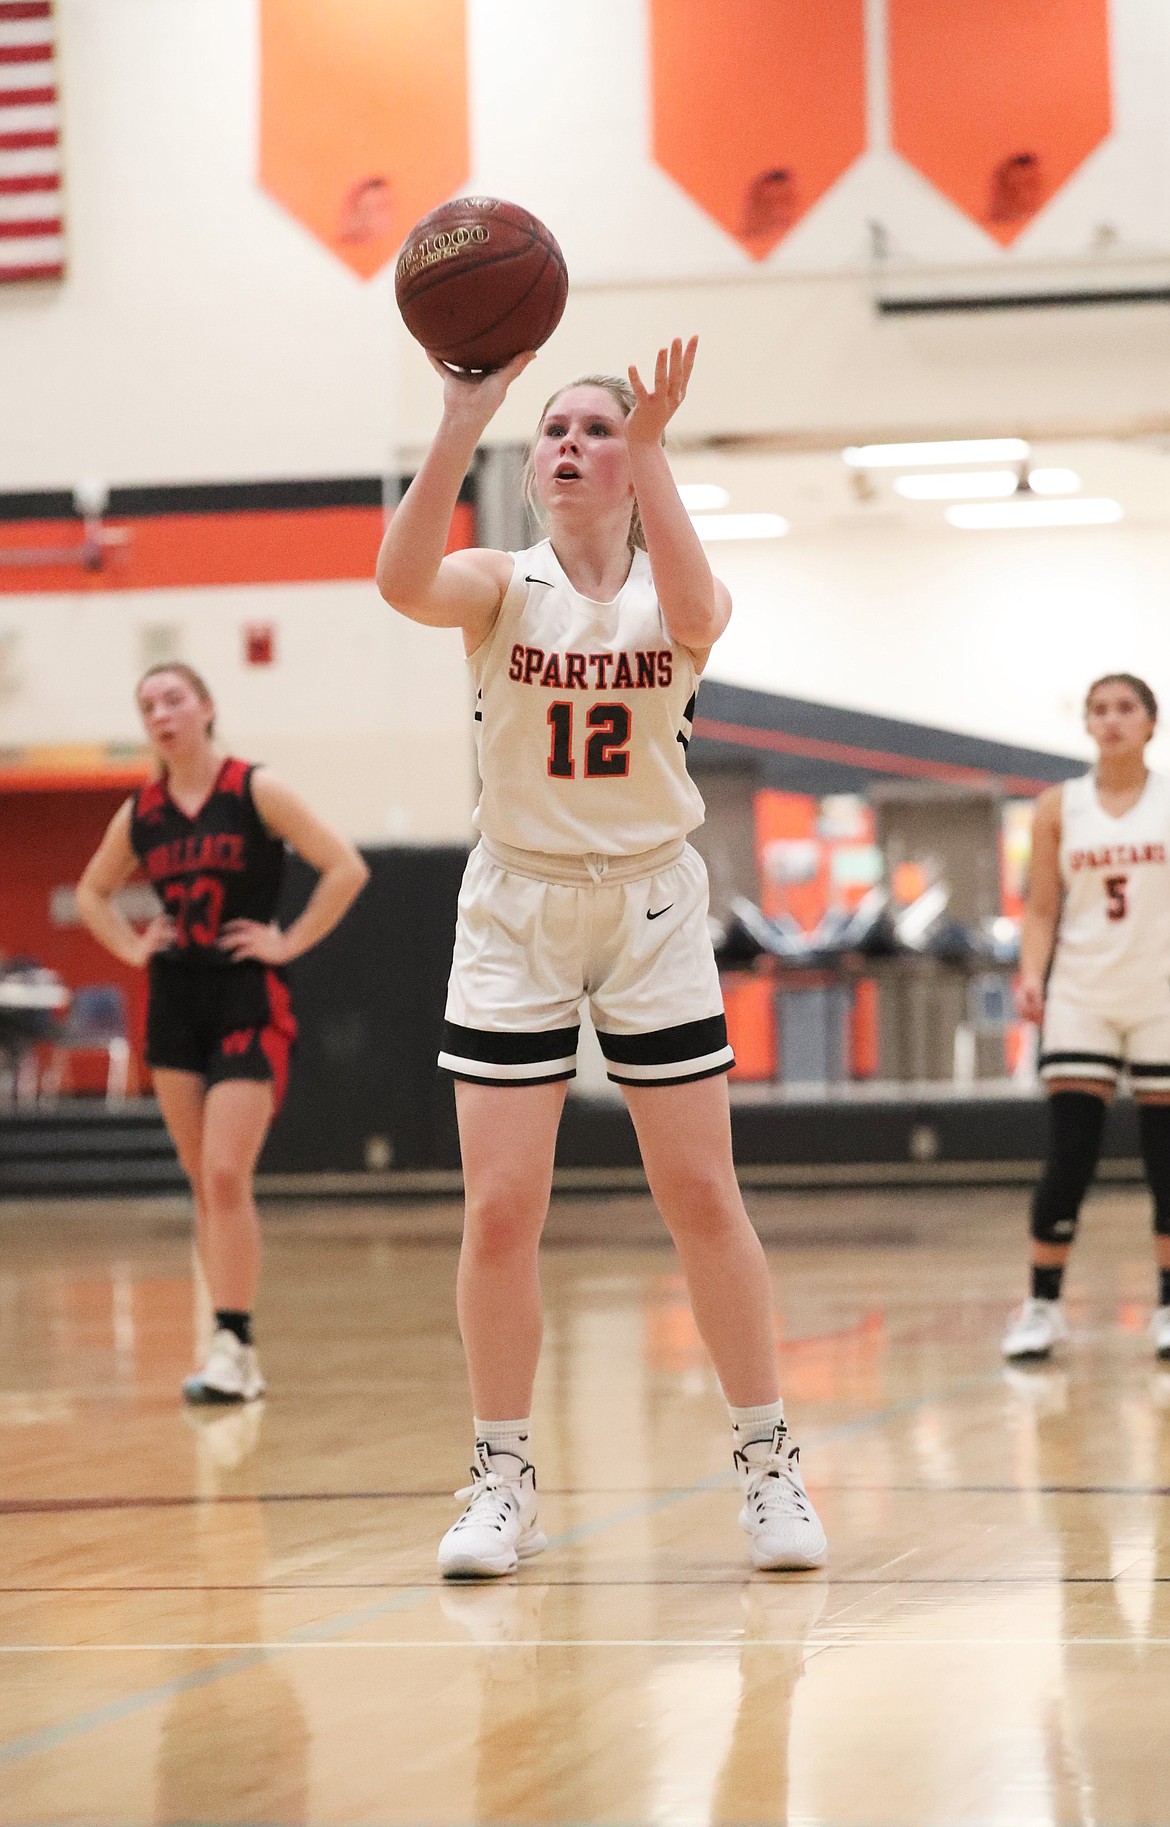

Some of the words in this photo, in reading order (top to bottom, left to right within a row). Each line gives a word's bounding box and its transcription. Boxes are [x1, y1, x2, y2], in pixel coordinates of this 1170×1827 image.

[509, 643, 673, 690] SPARTANS
[547, 701, 632, 779] 12
[1104, 876, 1127, 921] 5
